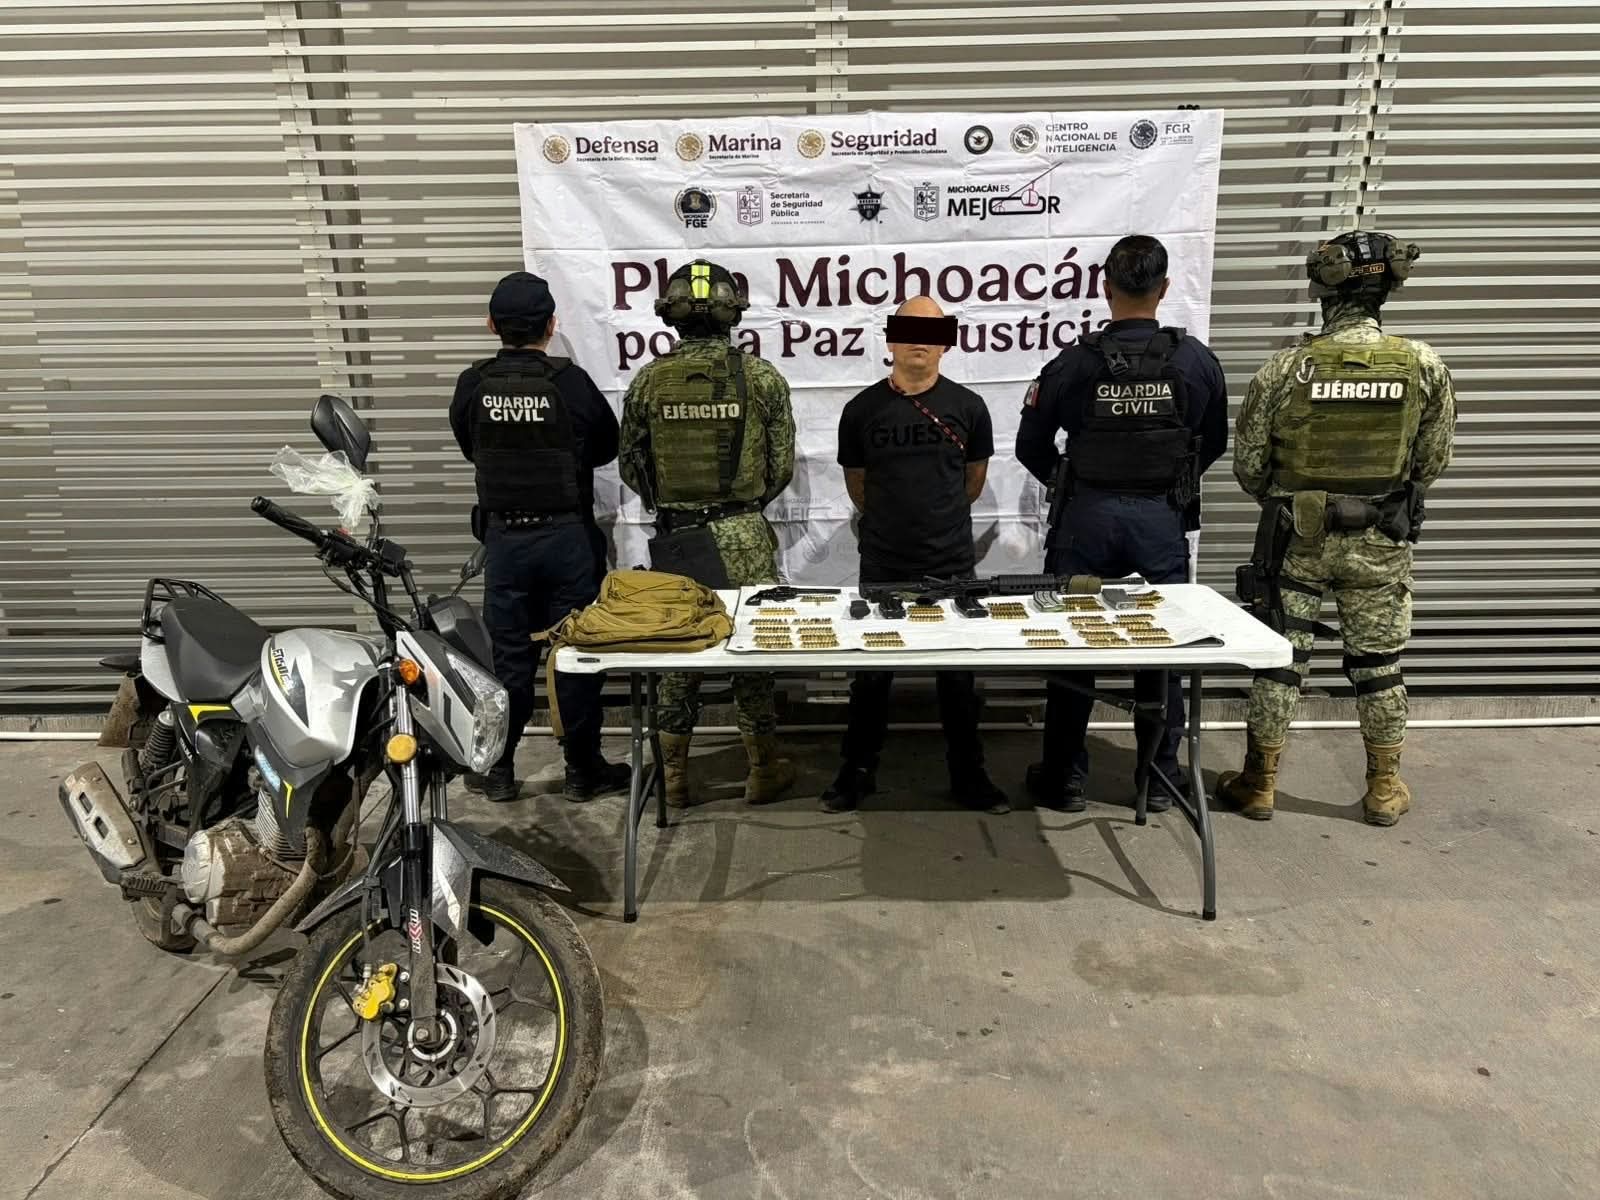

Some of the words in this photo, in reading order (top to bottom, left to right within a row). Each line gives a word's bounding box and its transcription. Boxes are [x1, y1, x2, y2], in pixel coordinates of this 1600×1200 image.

[1045, 122, 1088, 132] CENTRO
[1165, 123, 1190, 135] FGR
[708, 133, 782, 152] Marina
[831, 128, 937, 151] Seguridad
[1045, 132, 1100, 142] NACIONAL
[1103, 132, 1118, 141] DE
[575, 136, 659, 154] Defensa
[1045, 143, 1117, 153] INTELIGENCIA
[947, 185, 999, 194] MICHOACÁN
[1000, 184, 1010, 192] ES
[782, 199, 823, 209] Seguridad
[947, 196, 1061, 221] MEJOR
[770, 208, 800, 217] Pública
[686, 219, 708, 229] FGE
[616, 330, 677, 371] po
[781, 319, 865, 358] Paz
[944, 309, 1113, 353] ustici
[1097, 383, 1172, 398] GUARDIA
[1311, 380, 1404, 399] EJÉRCITO
[482, 395, 551, 409] GUARDIA
[1111, 401, 1158, 415] CIVIL
[489, 408, 545, 422] CIVIL
[662, 402, 740, 420] EJÉRCITO
[871, 422, 956, 449] GUES
